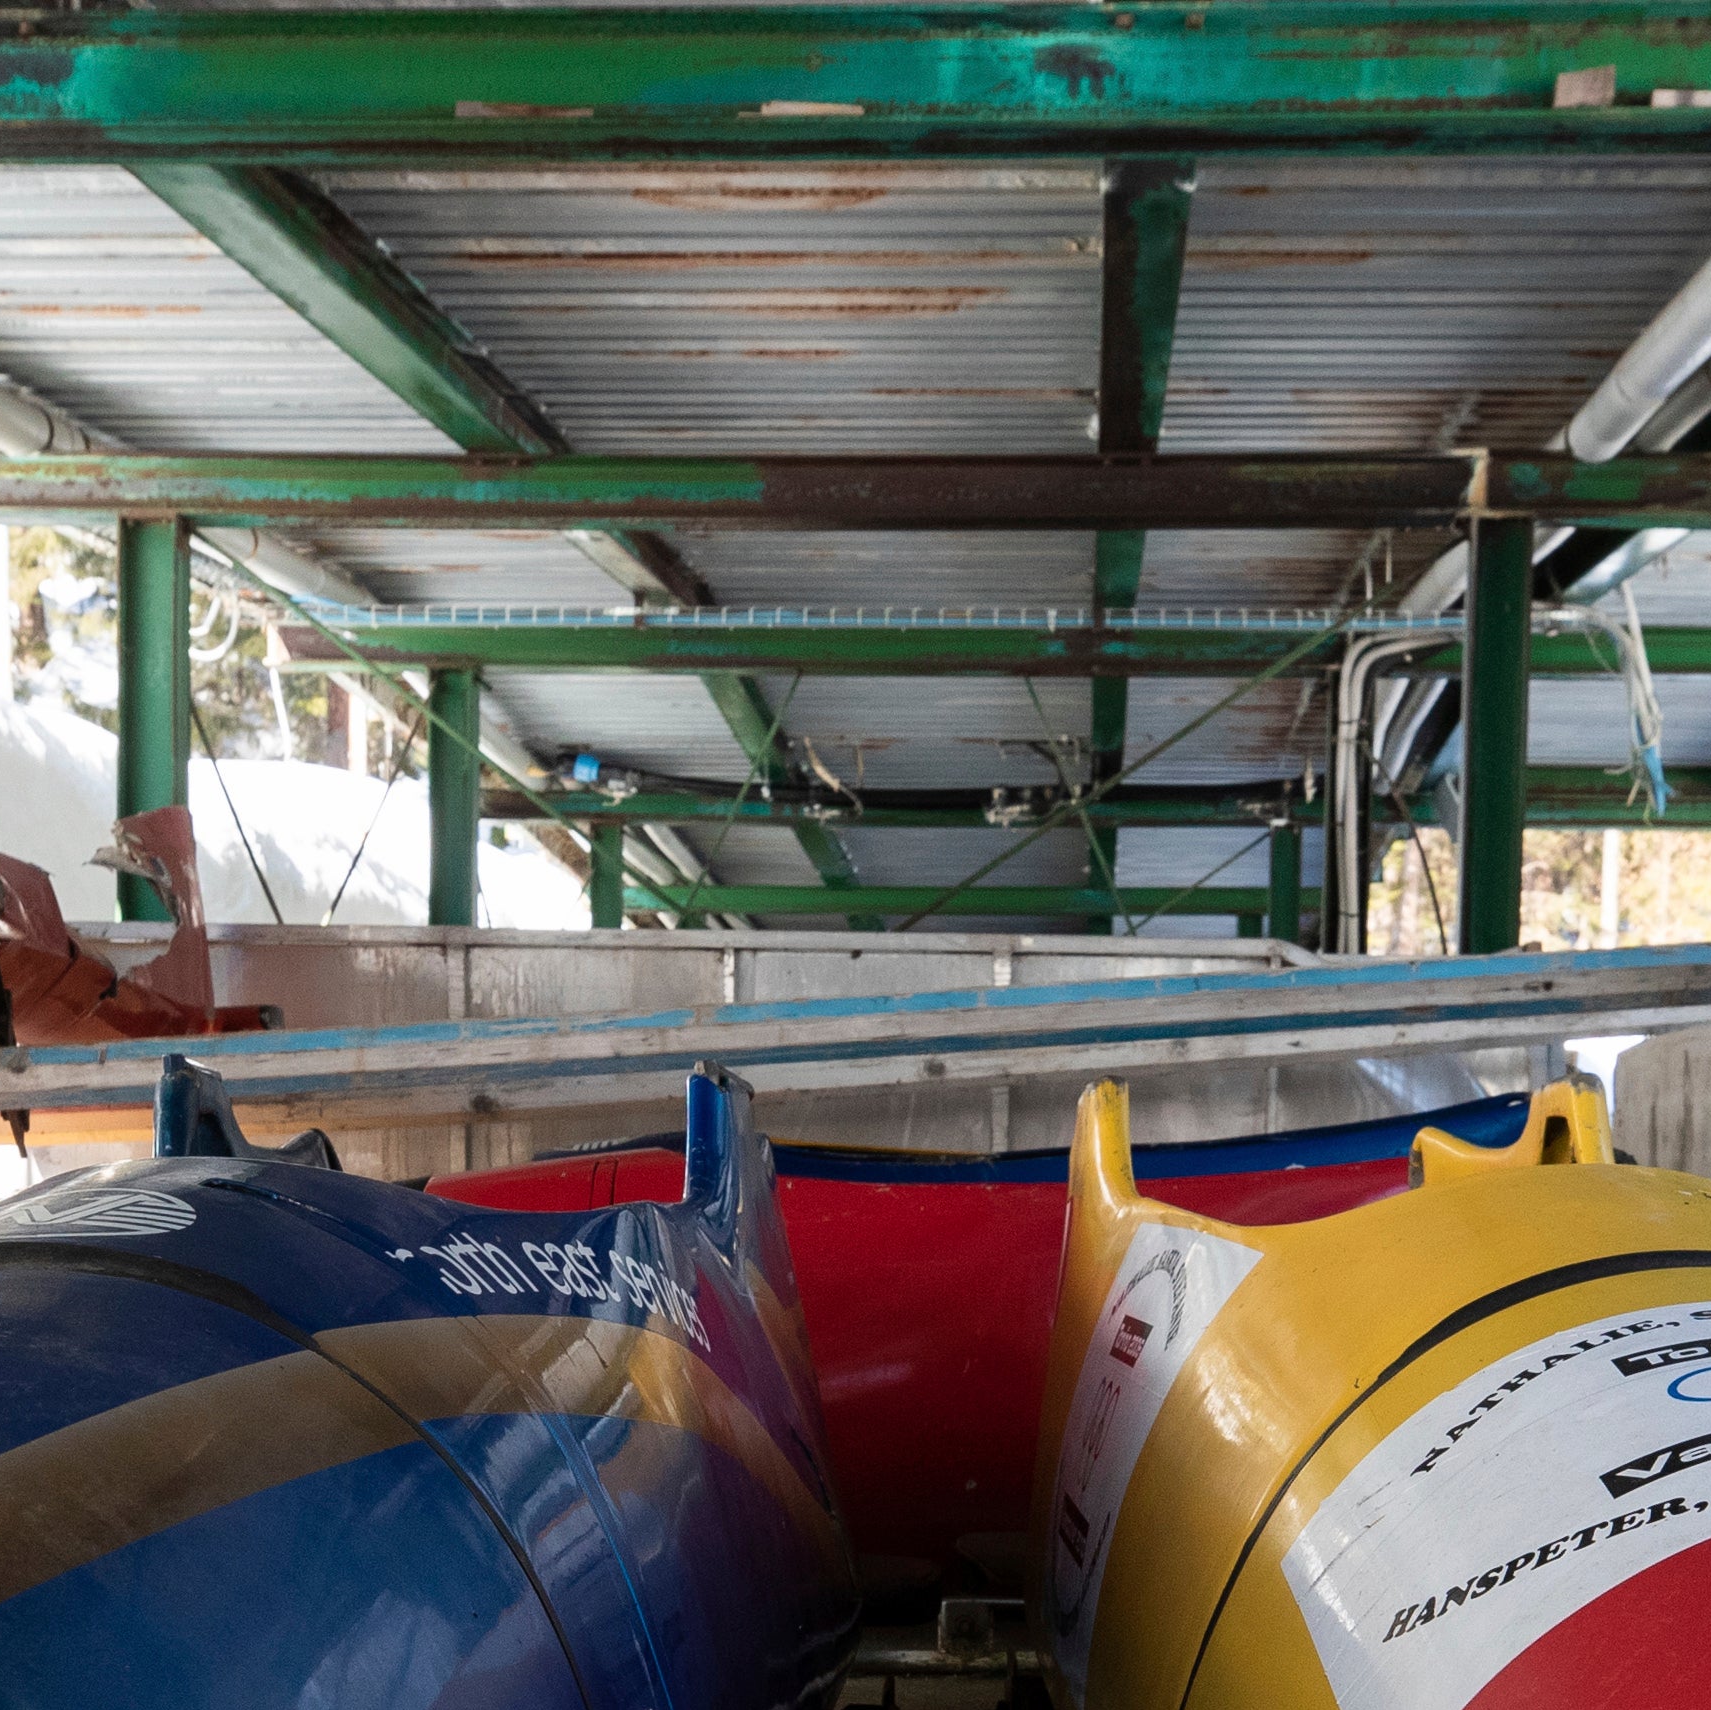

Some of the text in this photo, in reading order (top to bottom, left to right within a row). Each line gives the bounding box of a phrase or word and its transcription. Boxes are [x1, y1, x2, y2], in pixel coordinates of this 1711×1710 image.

[521, 1239, 622, 1302] east
[1409, 1319, 1681, 1478] NATHALIE,
[1381, 1496, 1709, 1643] HANSPETER,
